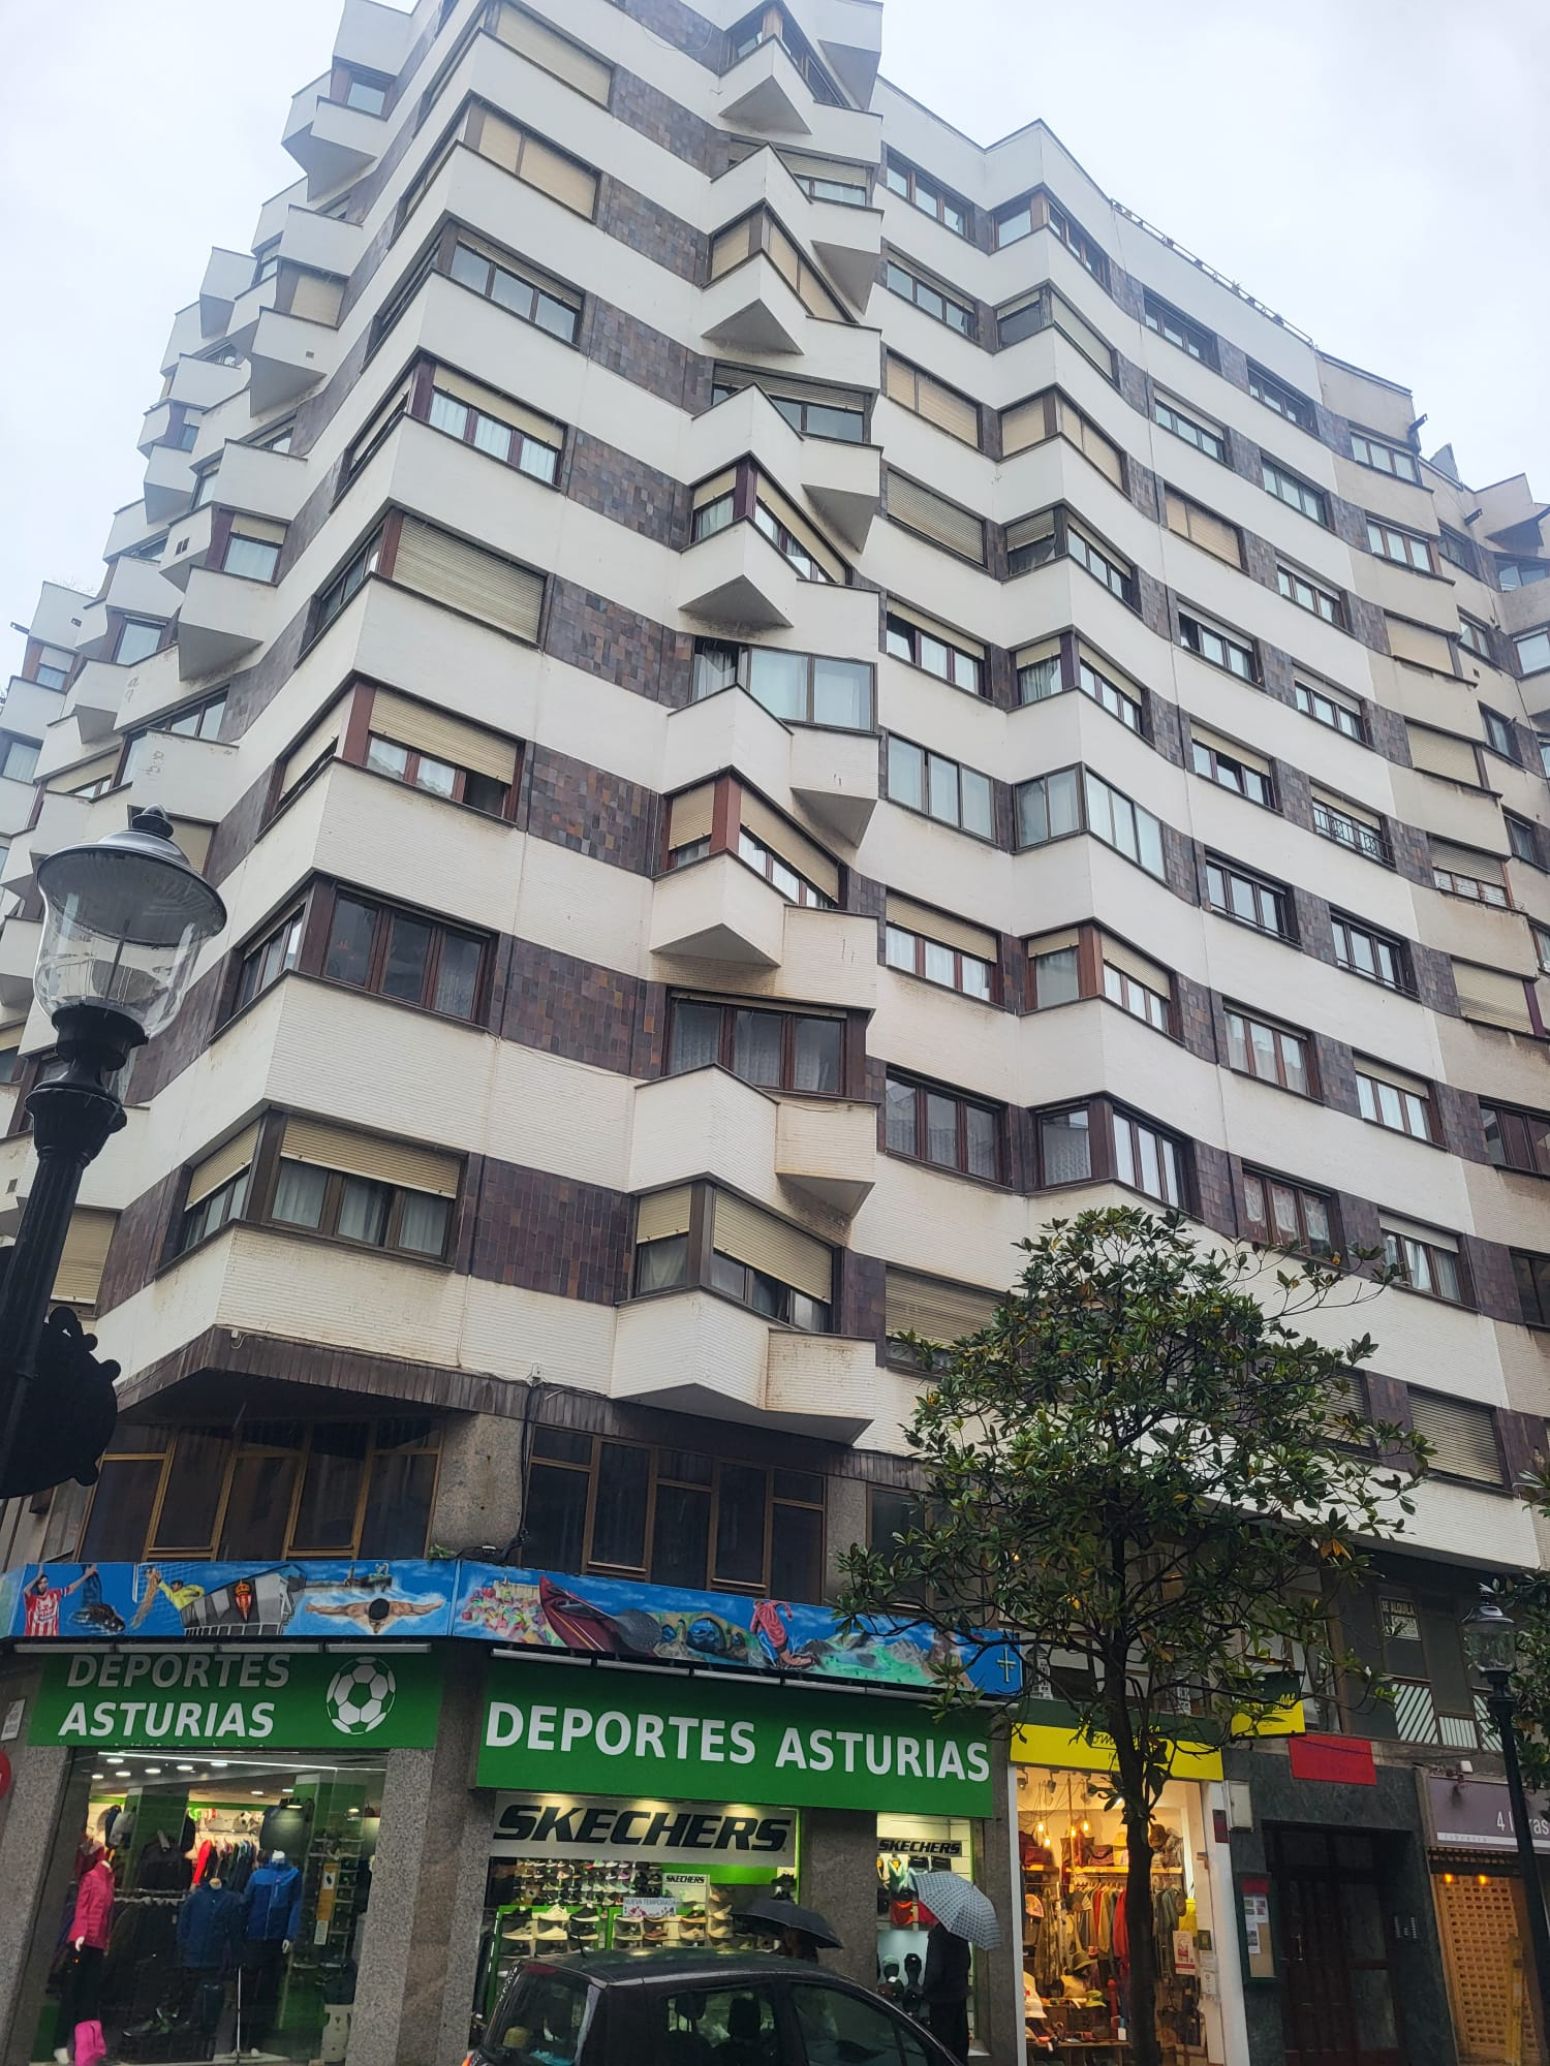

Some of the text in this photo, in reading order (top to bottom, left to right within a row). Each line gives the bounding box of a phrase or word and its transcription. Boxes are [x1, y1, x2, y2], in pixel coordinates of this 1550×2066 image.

[67, 1654, 291, 1687] DEPORTES
[58, 1702, 275, 1737] ASTURIAS
[485, 1702, 991, 1783] DEPORTES ASTURIAS
[493, 1804, 791, 1852] SKECHERS
[1496, 1810, 1549, 1835] 4 las
[878, 1839, 961, 1855] SKECHERS
[666, 1875, 704, 1883] SKECHERS
